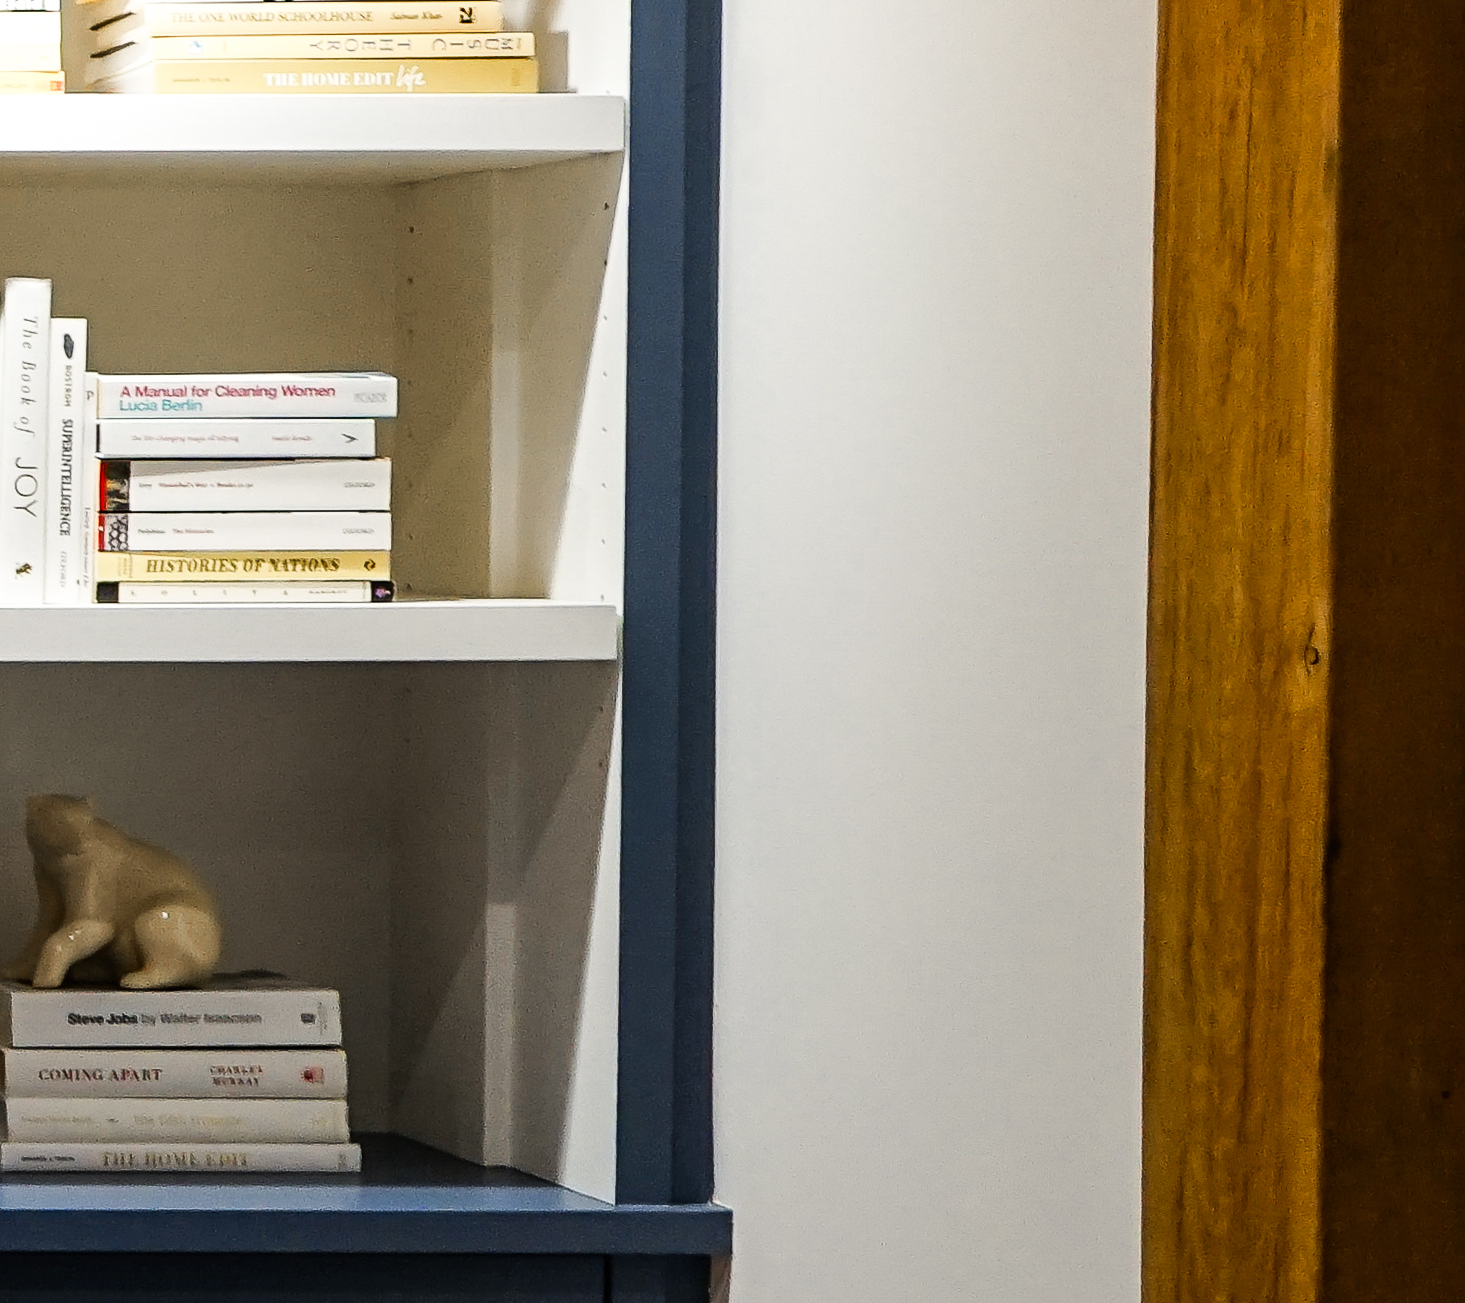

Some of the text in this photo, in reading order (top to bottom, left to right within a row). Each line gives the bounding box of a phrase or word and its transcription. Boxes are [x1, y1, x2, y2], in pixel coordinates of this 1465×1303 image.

[264, 73, 299, 86] THE
[303, 73, 351, 86] HOME
[354, 72, 394, 86] EDIT
[119, 386, 335, 399] A Manual for Cleaning Women
[146, 559, 339, 573] HISTORIES OF NATIONS
[67, 1014, 138, 1025] Steve Jobs
[38, 1069, 162, 1082] COMING APART
